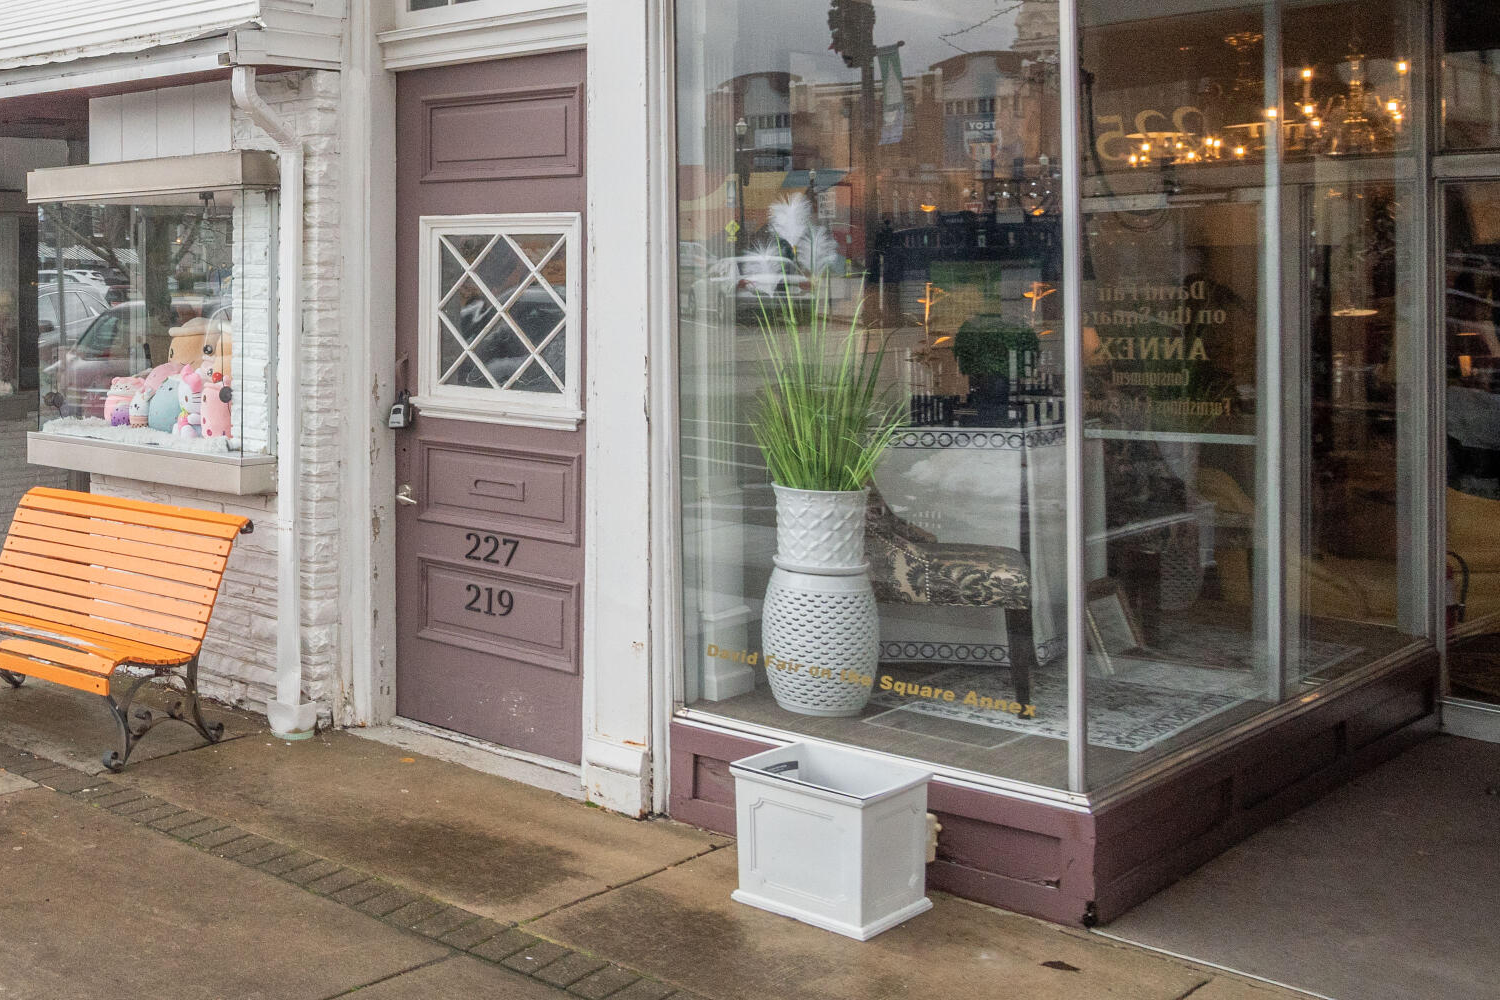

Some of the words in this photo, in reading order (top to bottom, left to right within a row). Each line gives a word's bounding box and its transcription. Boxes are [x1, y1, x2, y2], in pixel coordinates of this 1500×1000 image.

[465, 533, 519, 567] 227
[465, 583, 514, 617] 219
[707, 644, 758, 665] David
[764, 655, 802, 673] Fair
[809, 665, 833, 680] on
[840, 668, 874, 688] the
[880, 675, 956, 702] Square
[963, 690, 1037, 717] Annex
